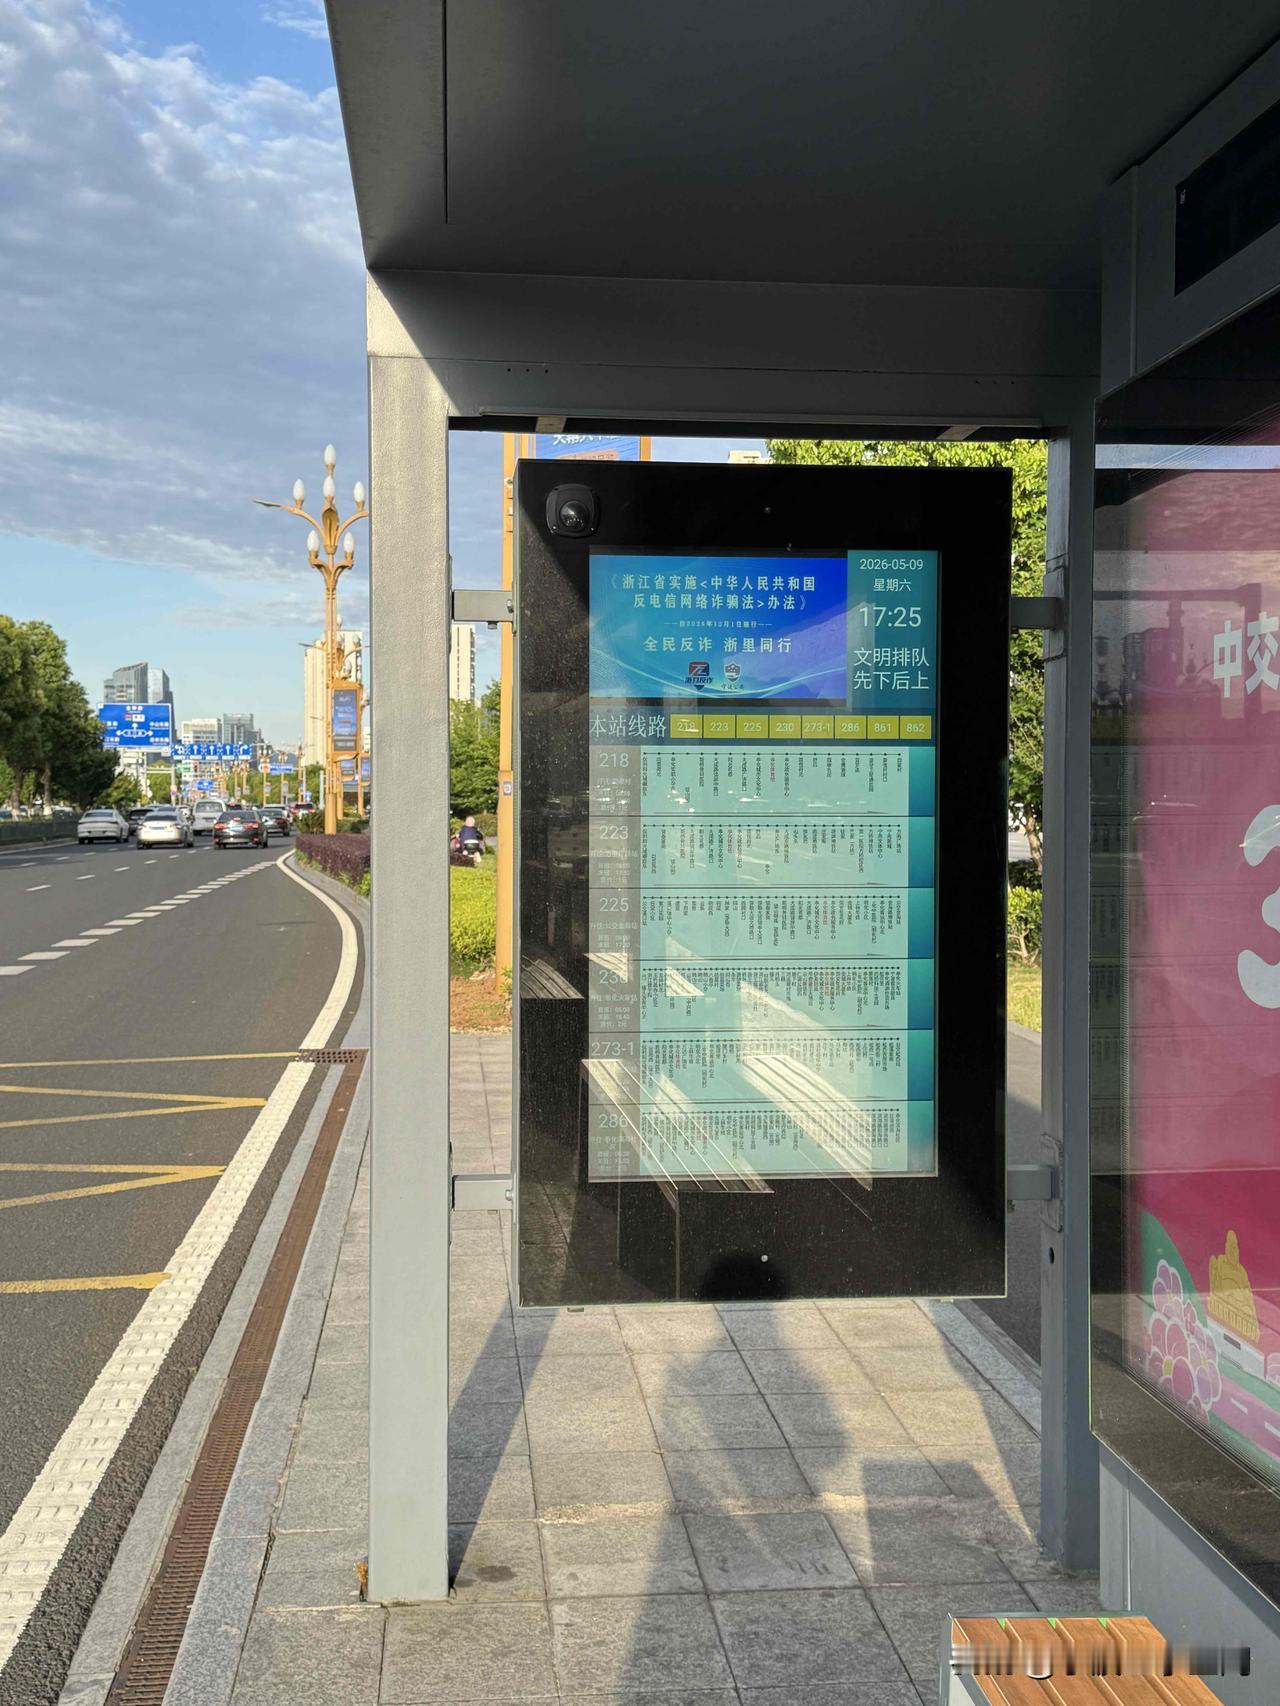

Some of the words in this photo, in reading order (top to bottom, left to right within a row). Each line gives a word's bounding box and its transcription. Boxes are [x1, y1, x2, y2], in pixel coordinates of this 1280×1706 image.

[860, 559, 924, 570] 2026-05-09
[873, 578, 912, 592] 星期六
[859, 607, 922, 628] 17:25
[644, 636, 713, 652] 全民反诈
[723, 637, 792, 653] 浙里同行
[853, 648, 930, 668] 文明排队
[853, 670, 930, 691] 先下后上
[589, 715, 666, 738] 本站线路
[677, 722, 696, 732] 218
[710, 722, 729, 732] 223
[743, 722, 762, 732] 225
[776, 722, 794, 732] 230
[804, 722, 831, 732] 273-1
[841, 722, 860, 732] 286
[874, 722, 892, 732] 861
[906, 722, 926, 732] 862
[599, 753, 629, 768] 218
[599, 825, 629, 840] 223
[599, 898, 629, 912] 225
[591, 1042, 634, 1056] 273-1
[599, 1114, 629, 1129] 286
